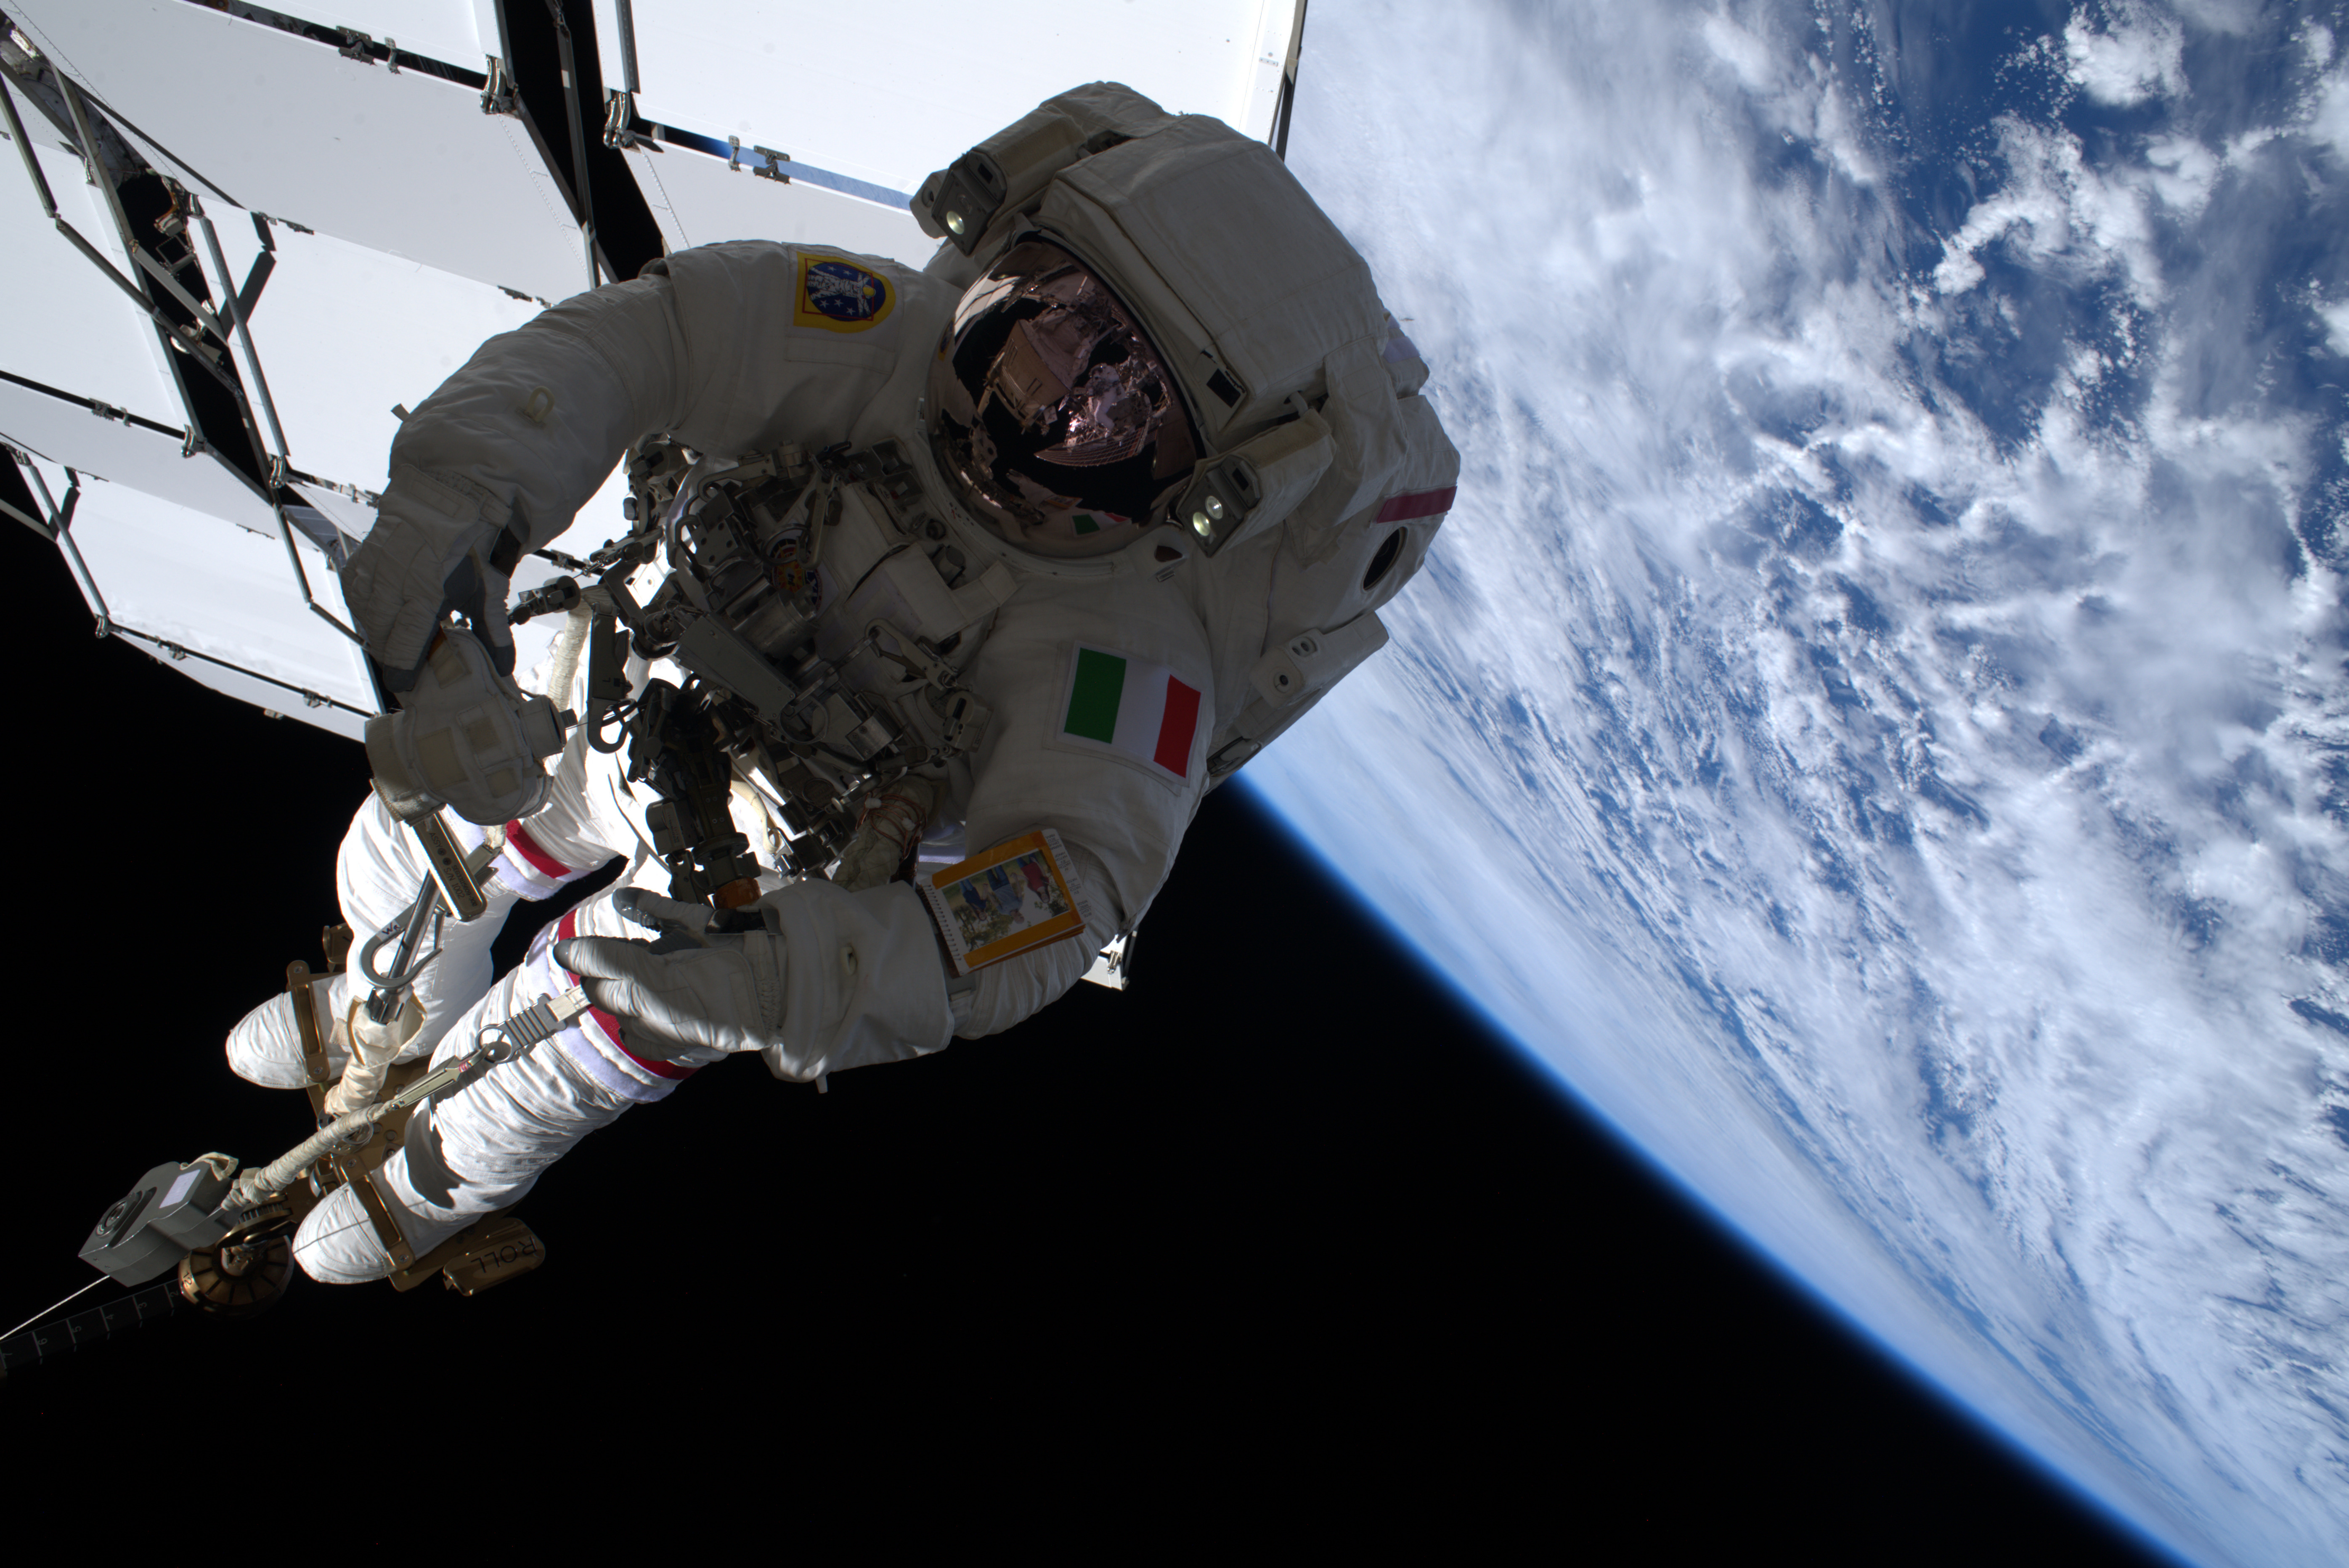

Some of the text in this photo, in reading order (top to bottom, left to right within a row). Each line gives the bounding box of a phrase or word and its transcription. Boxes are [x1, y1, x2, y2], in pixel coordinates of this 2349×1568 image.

[429, 833, 442, 848] ASSY
[444, 867, 465, 899] S/N 1002
[470, 1236, 537, 1273] ROLL
[183, 1271, 192, 1287] 12
